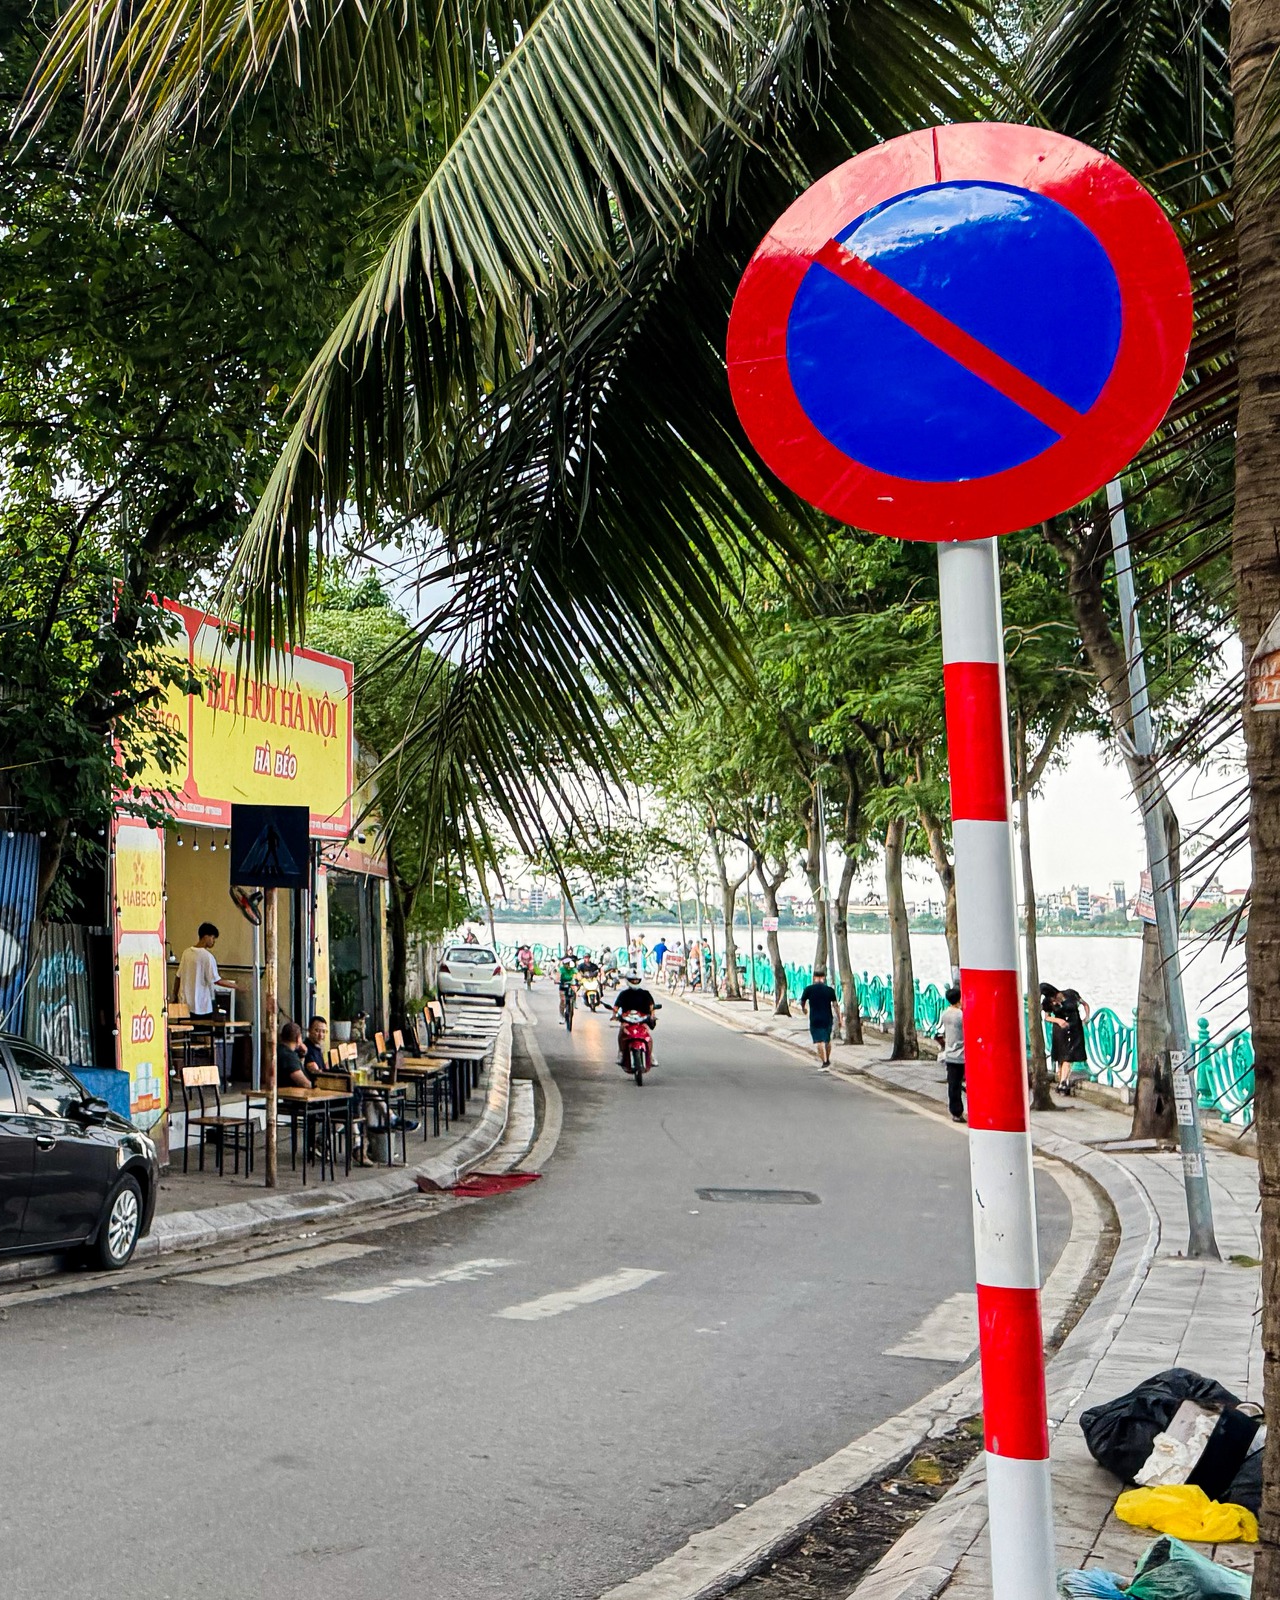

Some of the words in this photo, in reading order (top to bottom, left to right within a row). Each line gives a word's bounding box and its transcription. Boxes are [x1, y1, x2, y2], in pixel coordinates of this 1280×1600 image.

[280, 681, 305, 732] HÀ
[307, 690, 337, 748] NỘI
[254, 740, 271, 775] HÀ
[274, 745, 297, 780] BÉO
[122, 889, 157, 908] HABECO
[133, 953, 150, 990] HÀ
[132, 1006, 154, 1043] BÉO
